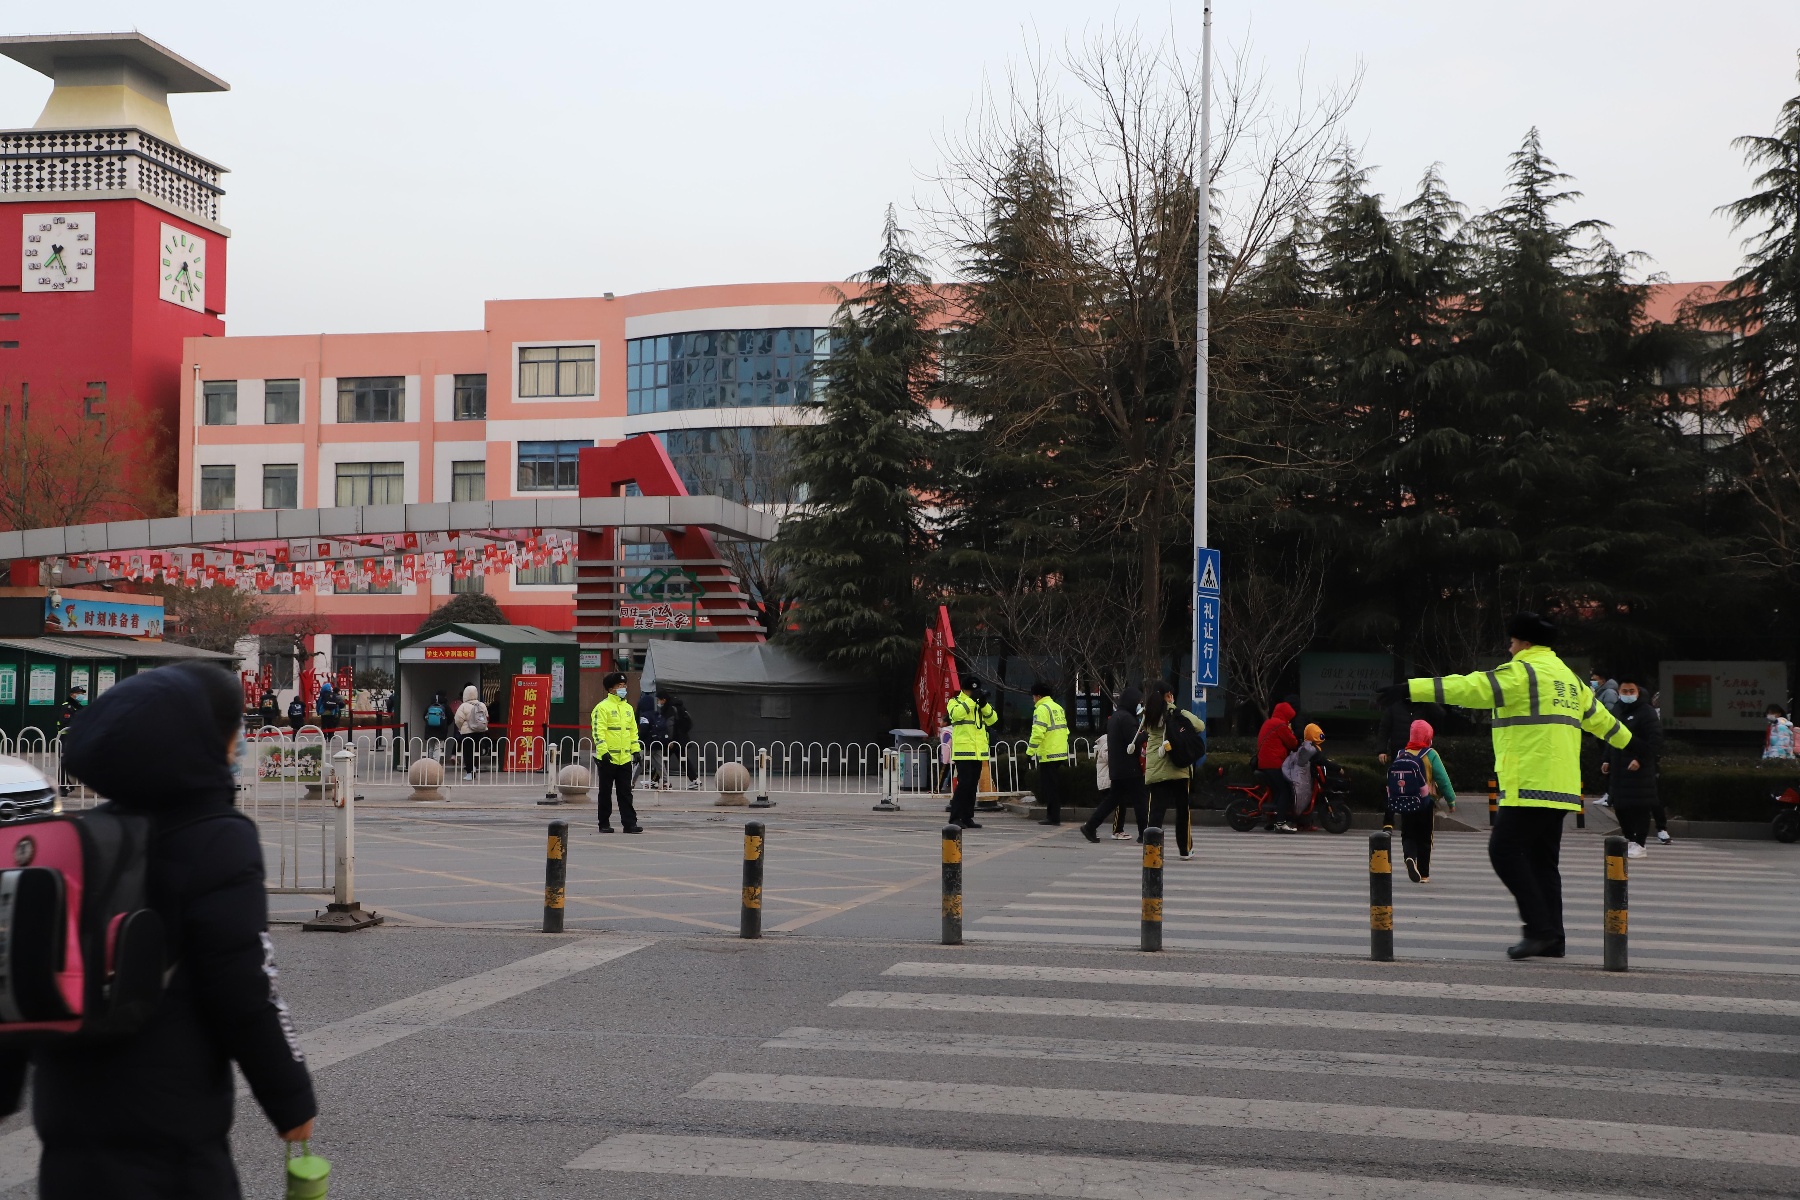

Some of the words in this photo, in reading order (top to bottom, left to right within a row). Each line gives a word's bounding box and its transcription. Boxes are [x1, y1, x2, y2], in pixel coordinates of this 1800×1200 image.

[84, 610, 139, 629] 时刻准备着
[620, 603, 673, 618] 同住一个城
[634, 612, 688, 629] 共爱一个家
[1202, 602, 1215, 679] 礼让行人
[517, 688, 538, 765] 临时留观点
